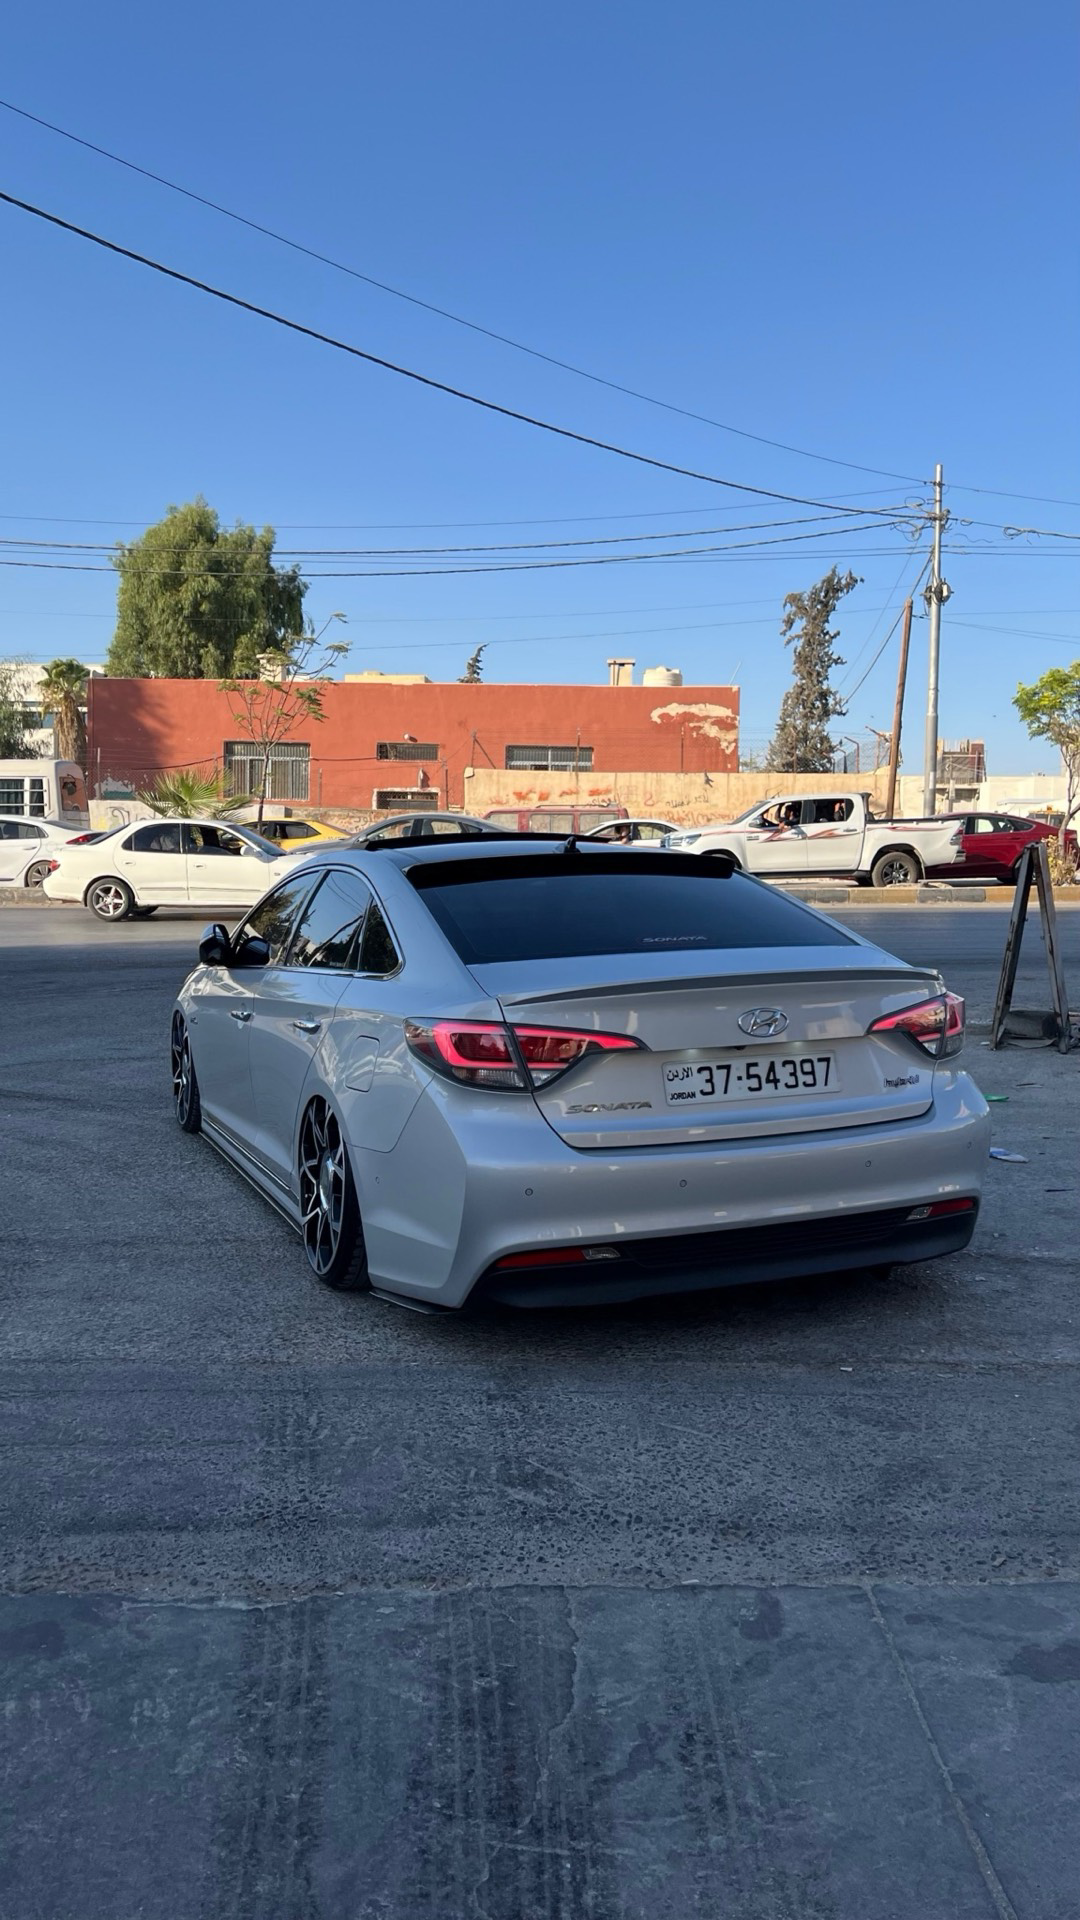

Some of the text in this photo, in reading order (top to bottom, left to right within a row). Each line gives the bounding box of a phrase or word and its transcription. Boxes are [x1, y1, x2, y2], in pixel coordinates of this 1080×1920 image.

[642, 935, 708, 943] SONATA
[669, 1091, 696, 1101] JORDAN
[564, 1101, 652, 1114] SONATA
